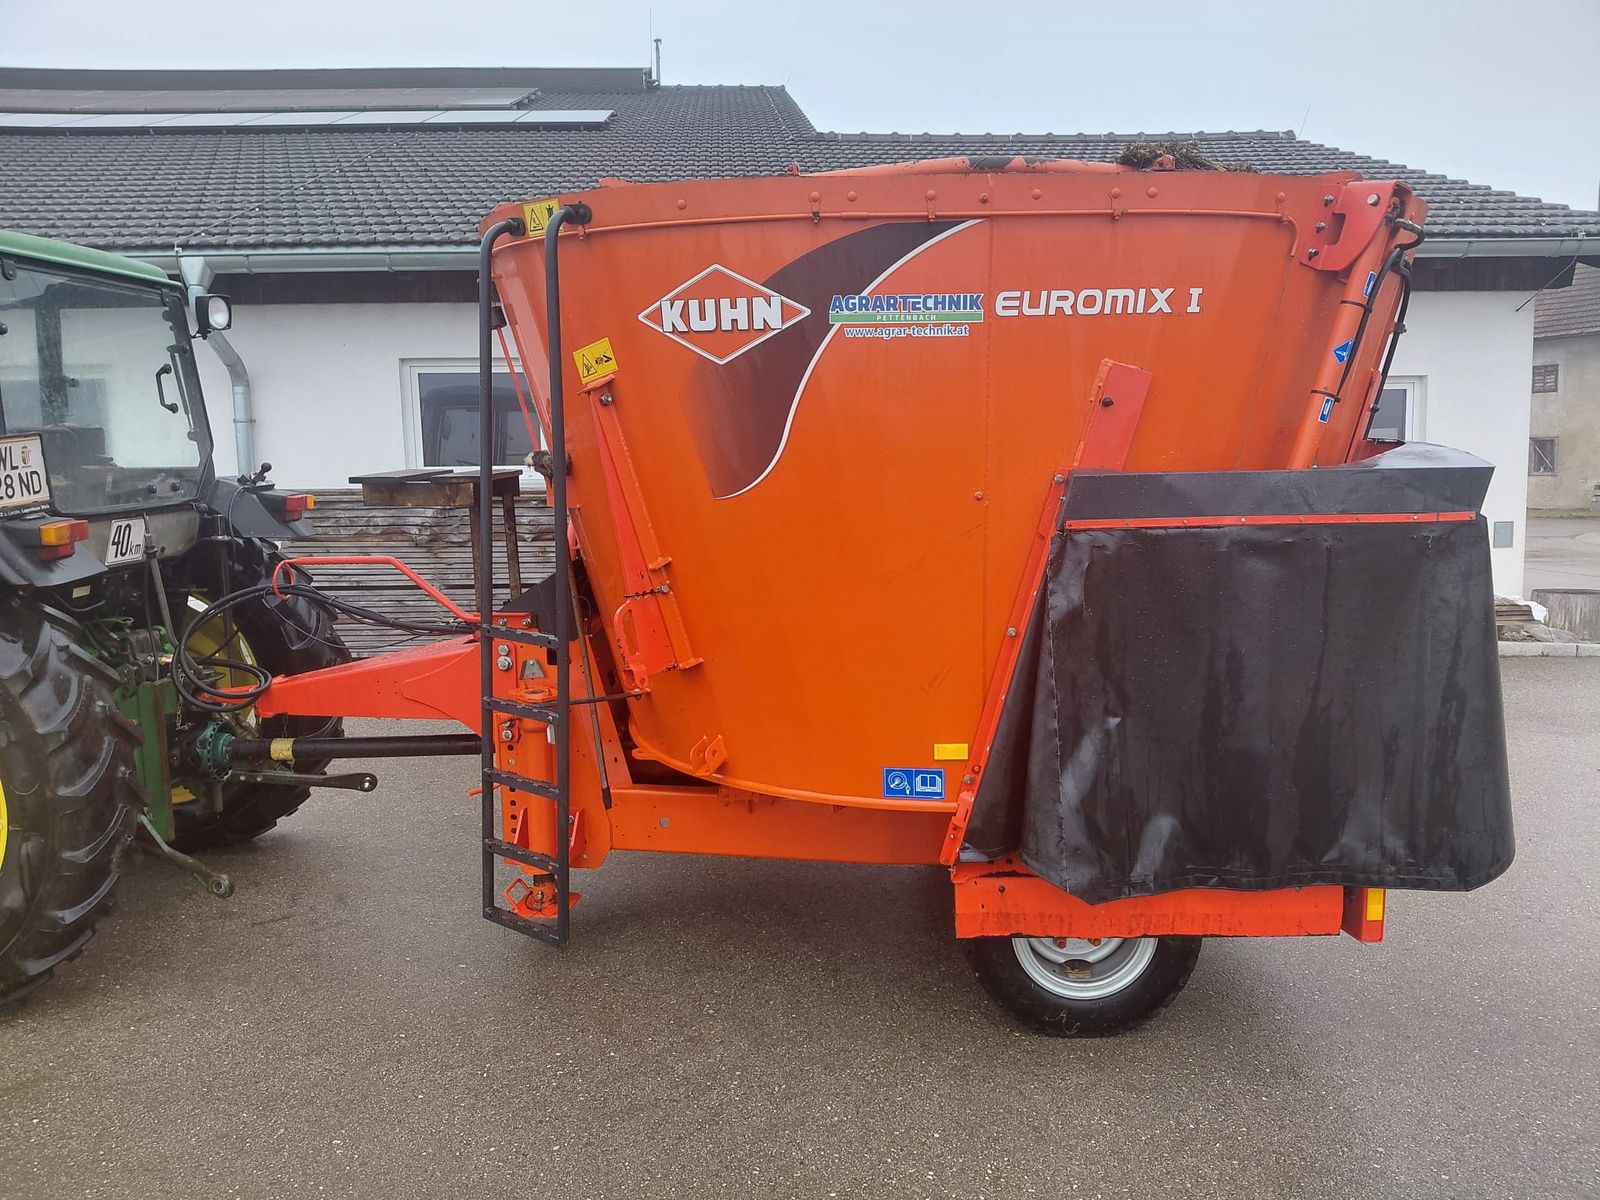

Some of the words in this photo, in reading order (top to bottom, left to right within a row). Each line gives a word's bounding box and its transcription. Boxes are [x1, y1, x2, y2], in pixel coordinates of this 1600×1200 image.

[830, 294, 983, 312] AGRARTECHNIK
[995, 287, 1175, 316] EUROMIX
[1186, 287, 1203, 313] I
[661, 296, 783, 333] KUHN
[876, 314, 937, 322] PETTENBACH
[844, 325, 969, 339] www.agrar-technik.at
[18, 470, 42, 497] ND
